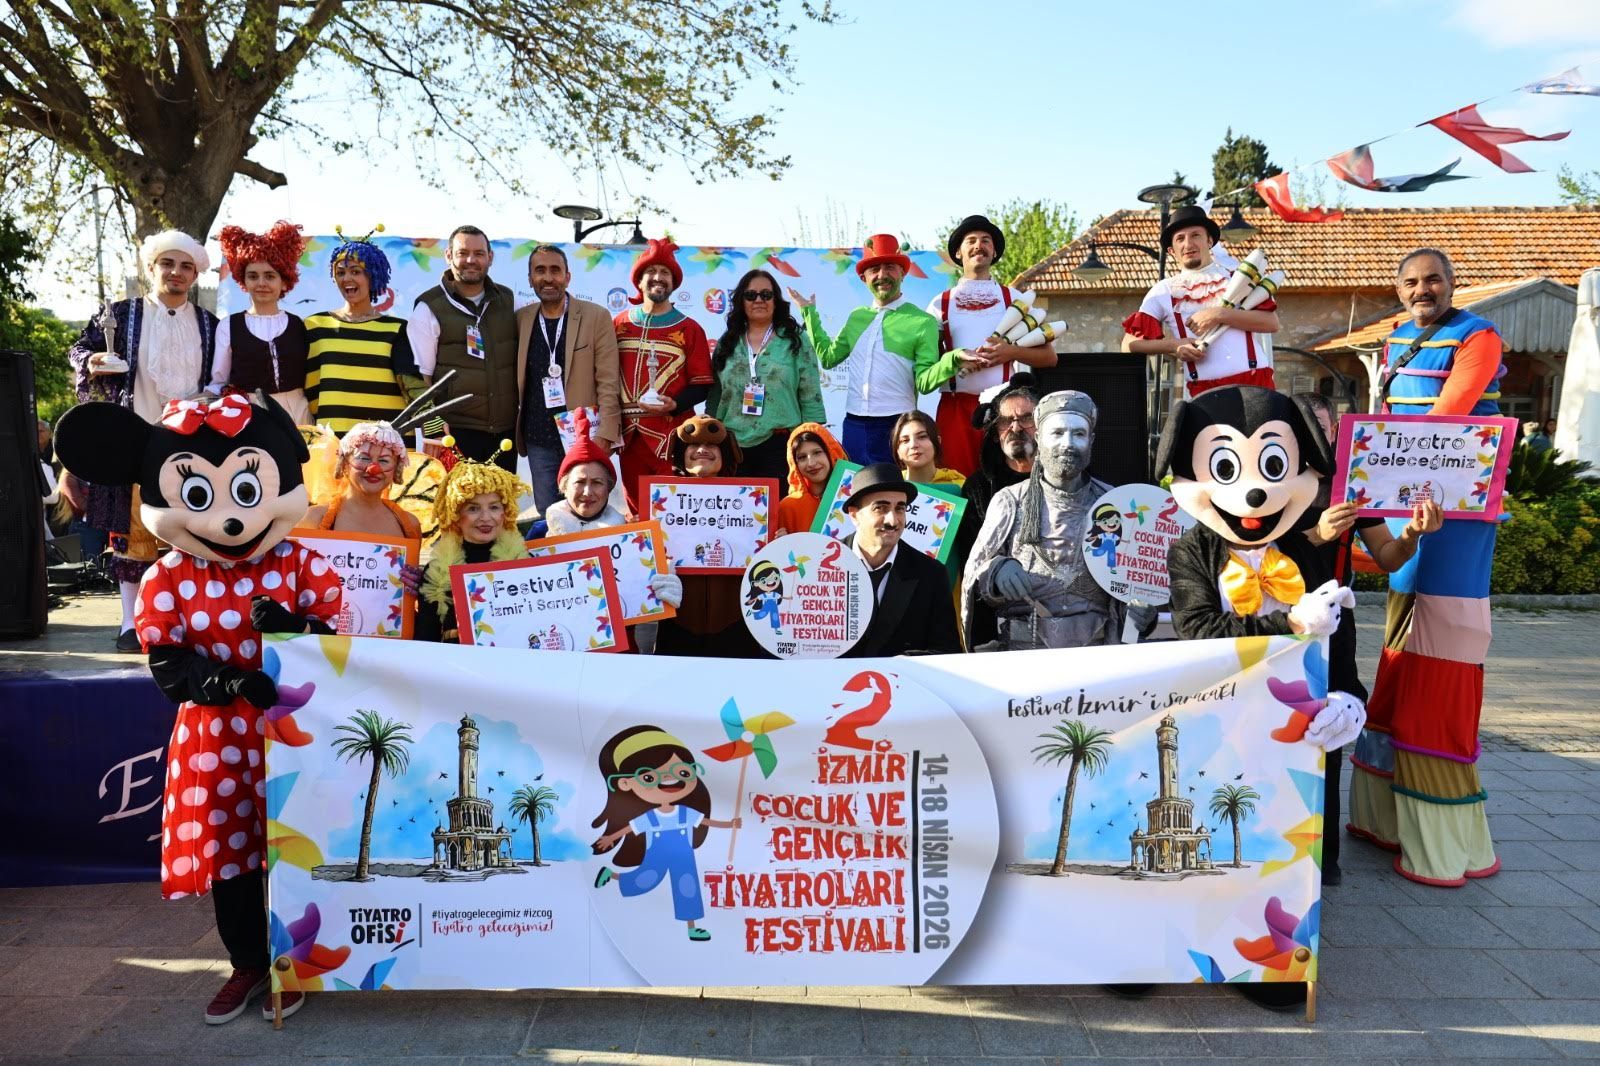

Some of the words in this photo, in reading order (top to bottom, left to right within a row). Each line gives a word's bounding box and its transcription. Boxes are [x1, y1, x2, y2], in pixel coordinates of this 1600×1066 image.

[1384, 431, 1466, 453] Tiyatro
[1367, 452, 1477, 471] Geleceğimiz
[677, 493, 743, 513] Tiyatro
[1158, 497, 1179, 522] 2
[665, 512, 754, 529] Geleceğimiz
[326, 551, 378, 570] atro
[820, 541, 842, 570] 2
[1115, 552, 1168, 575] TİYATROLA
[339, 574, 388, 591] eğimiz
[493, 571, 575, 598] Festival
[817, 567, 846, 582] İZMİR
[1126, 569, 1169, 588] FESTİVAL
[833, 585, 846, 597] VE
[537, 595, 590, 612] Sarıyor
[802, 598, 846, 613] GENÇLİK
[779, 611, 845, 626] TİYATROLARI
[850, 619, 859, 640] 2026
[822, 670, 892, 751] 2
[1008, 695, 1073, 718] Festival
[817, 739, 906, 785] İZMİR
[921, 753, 949, 813] 14-18
[752, 792, 856, 827] ÇOCUK
[867, 791, 906, 827] VE
[772, 827, 907, 866] GENÇLİK
[922, 819, 953, 878] NİSAN
[704, 865, 906, 908] TİYATROLARI
[432, 908, 521, 920] #tiyatrogelecegimiz
[523, 908, 553, 920] #izcog
[923, 885, 950, 950] 2026
[432, 919, 473, 936] Tiyatro
[745, 908, 906, 952] FESTİVALİ
